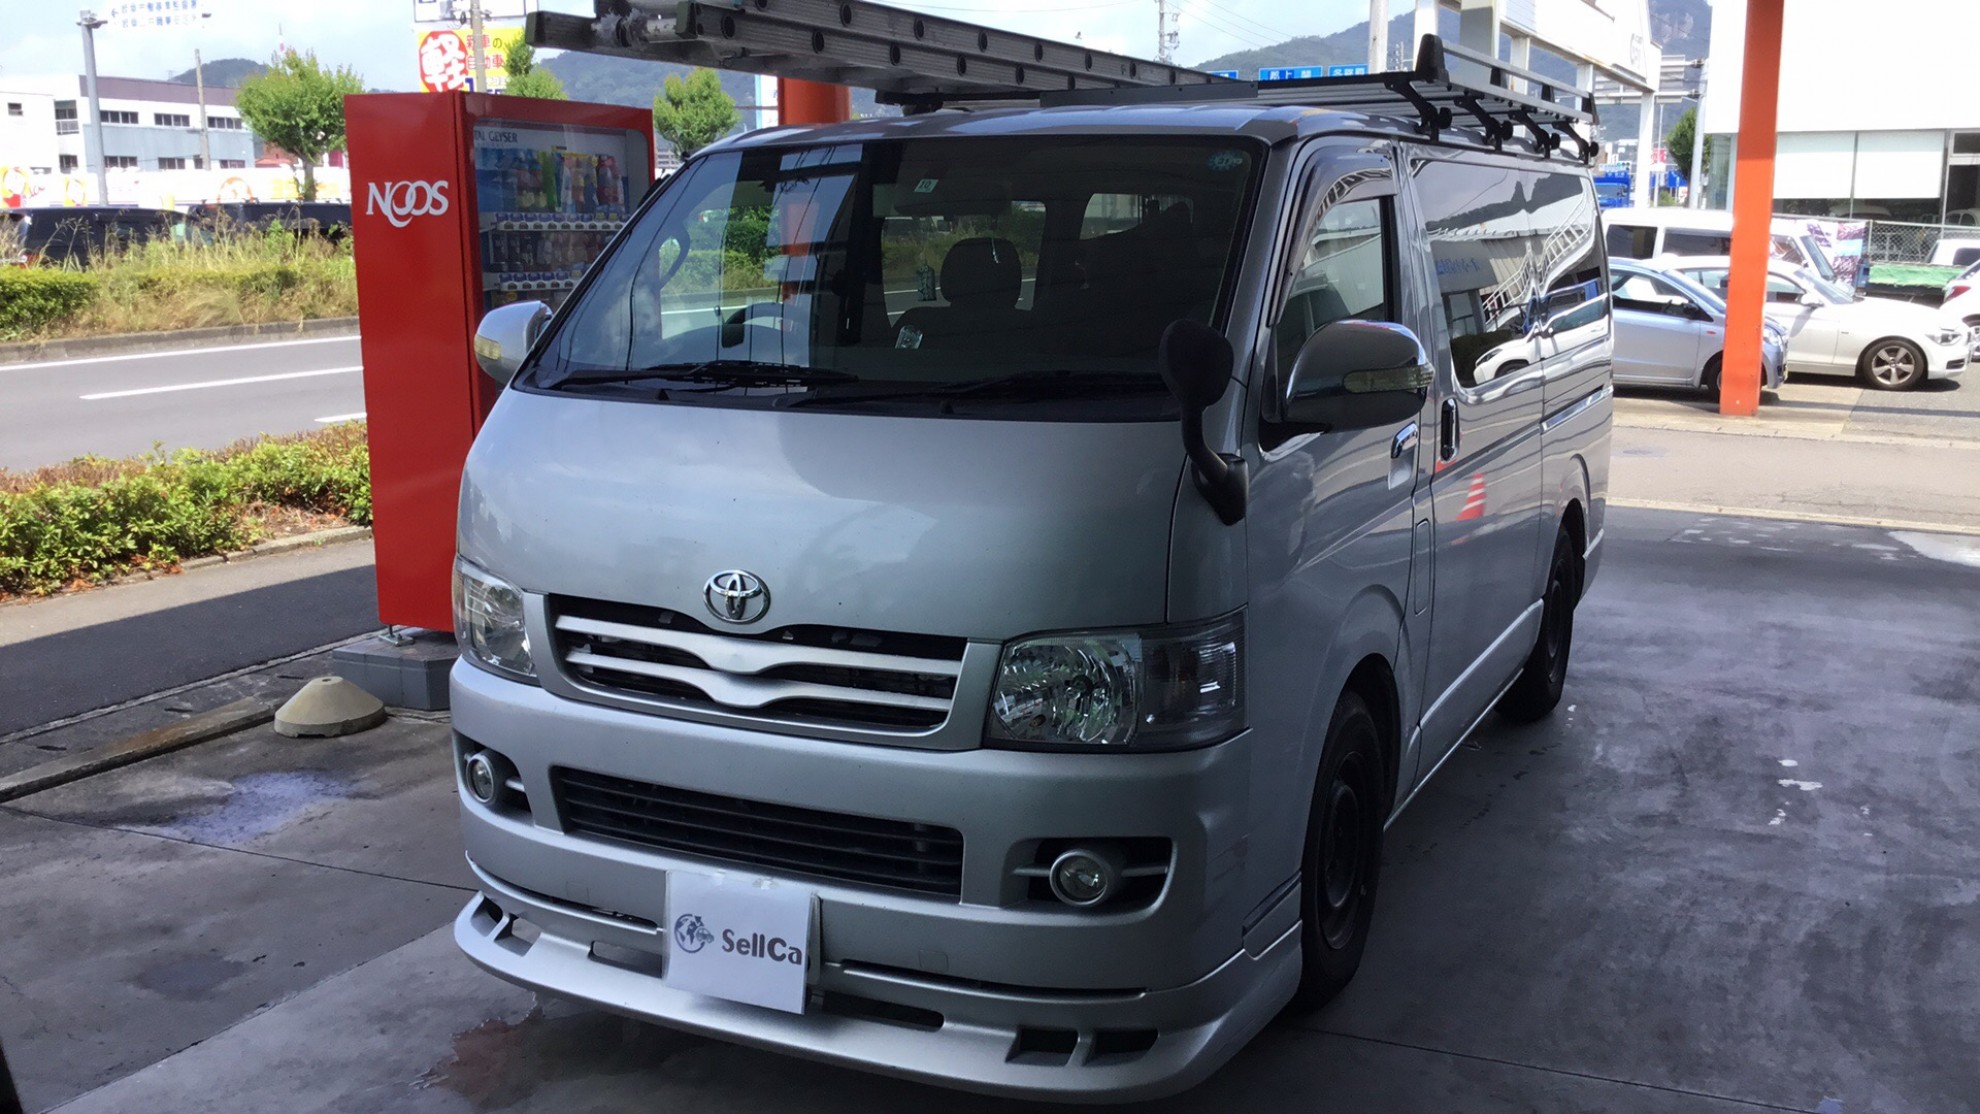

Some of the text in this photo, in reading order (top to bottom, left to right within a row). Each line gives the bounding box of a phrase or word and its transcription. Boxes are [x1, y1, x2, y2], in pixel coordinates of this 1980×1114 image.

[420, 33, 466, 92] 軽
[488, 131, 518, 143] GEYSER
[721, 928, 803, 966] SellCa
